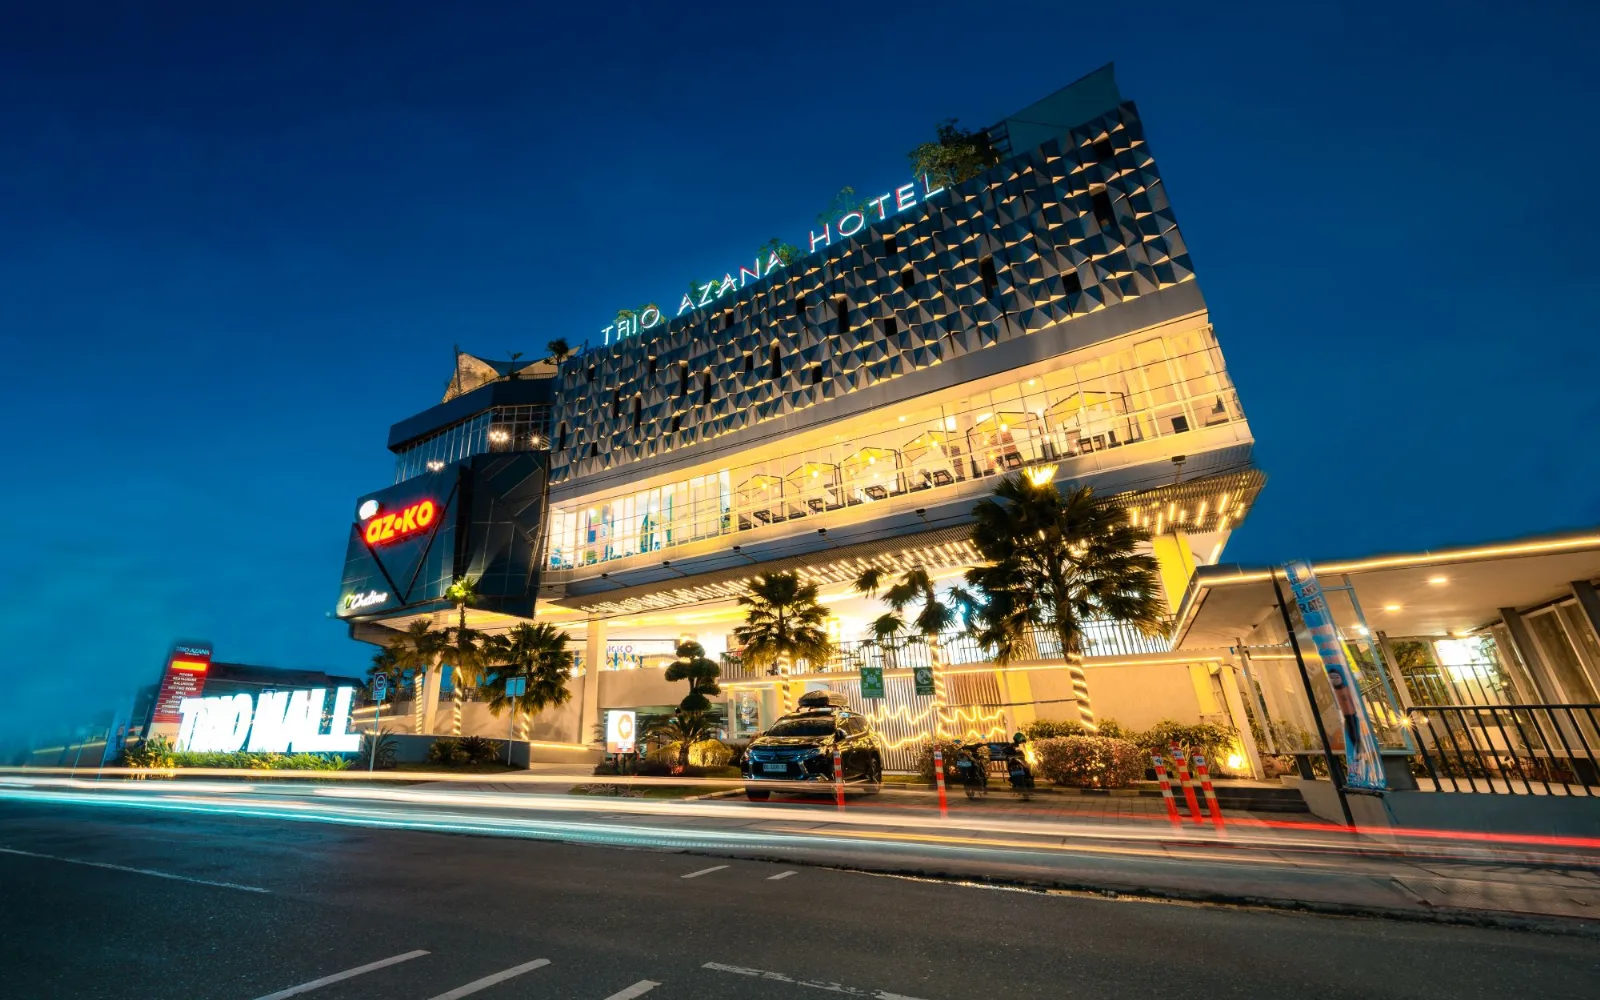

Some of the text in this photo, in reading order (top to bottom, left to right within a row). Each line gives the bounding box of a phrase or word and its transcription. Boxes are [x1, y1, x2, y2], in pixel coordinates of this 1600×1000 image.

[601, 172, 944, 346] TRIO AZANA HOTEL
